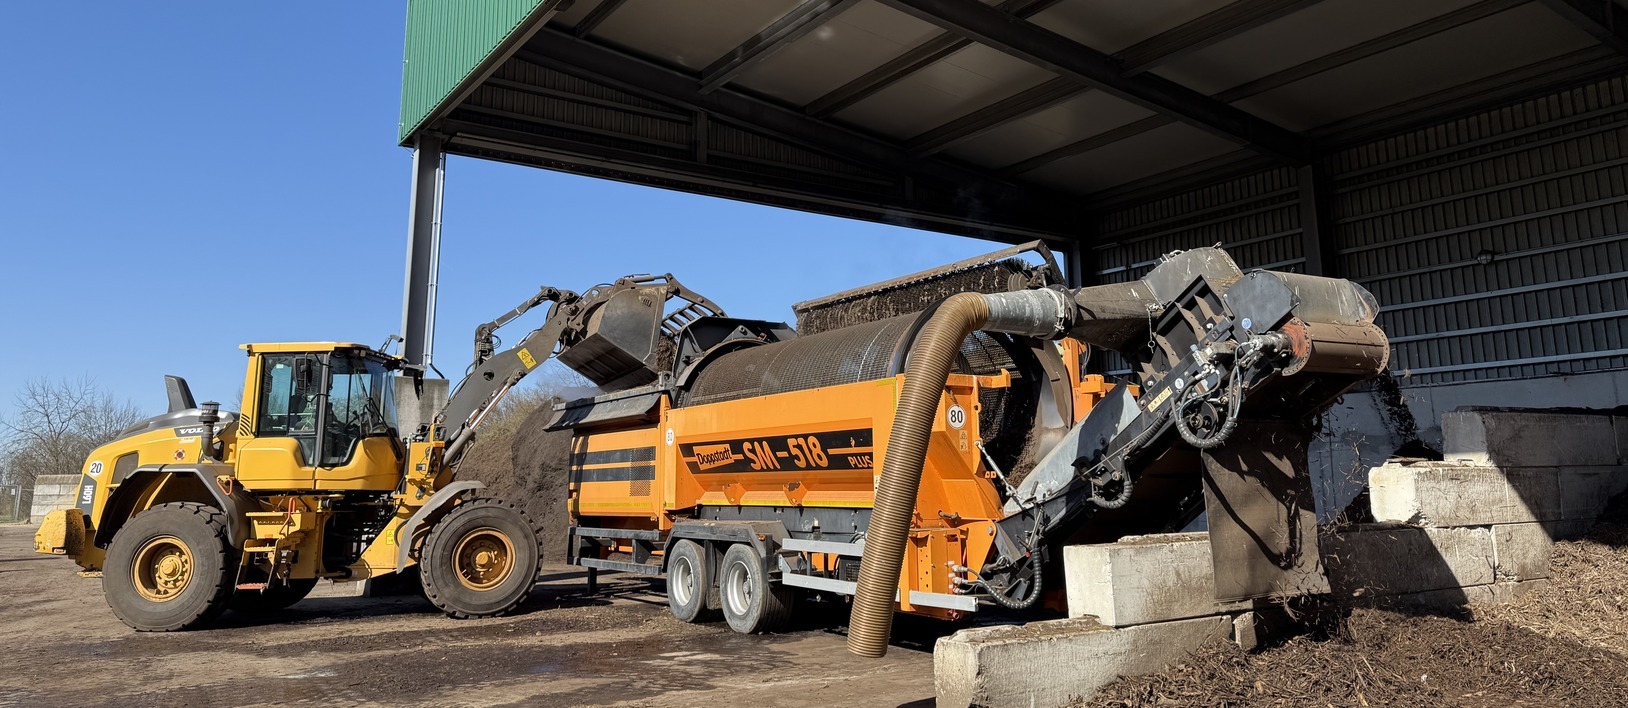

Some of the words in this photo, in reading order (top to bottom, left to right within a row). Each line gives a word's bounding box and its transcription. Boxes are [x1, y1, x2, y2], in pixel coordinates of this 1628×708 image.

[951, 410, 963, 423] 80
[696, 447, 732, 465] Doppstadt
[743, 436, 828, 470] SM-518
[91, 463, 102, 473] 20
[848, 456, 873, 468] PLUS
[82, 485, 94, 504] L60H
